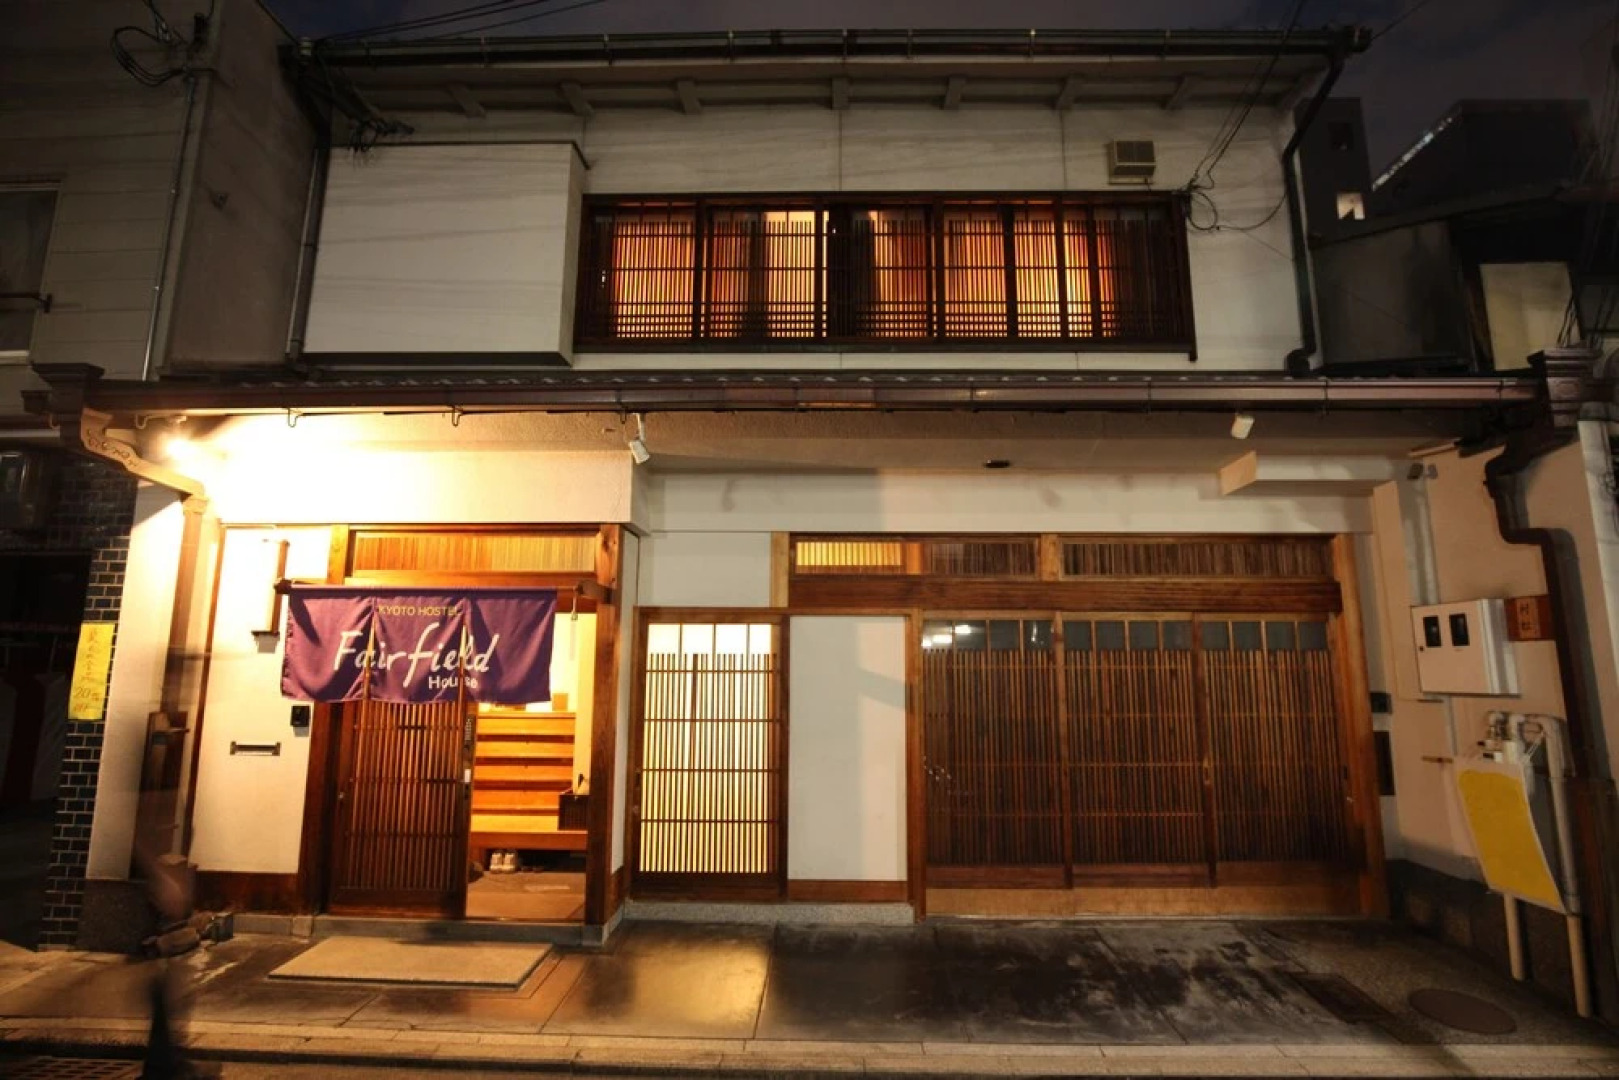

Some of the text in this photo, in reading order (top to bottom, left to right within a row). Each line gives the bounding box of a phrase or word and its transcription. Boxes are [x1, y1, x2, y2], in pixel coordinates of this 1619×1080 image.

[378, 605, 415, 616] KYOTO
[333, 621, 500, 688] Fairfield
[428, 675, 479, 689] House
